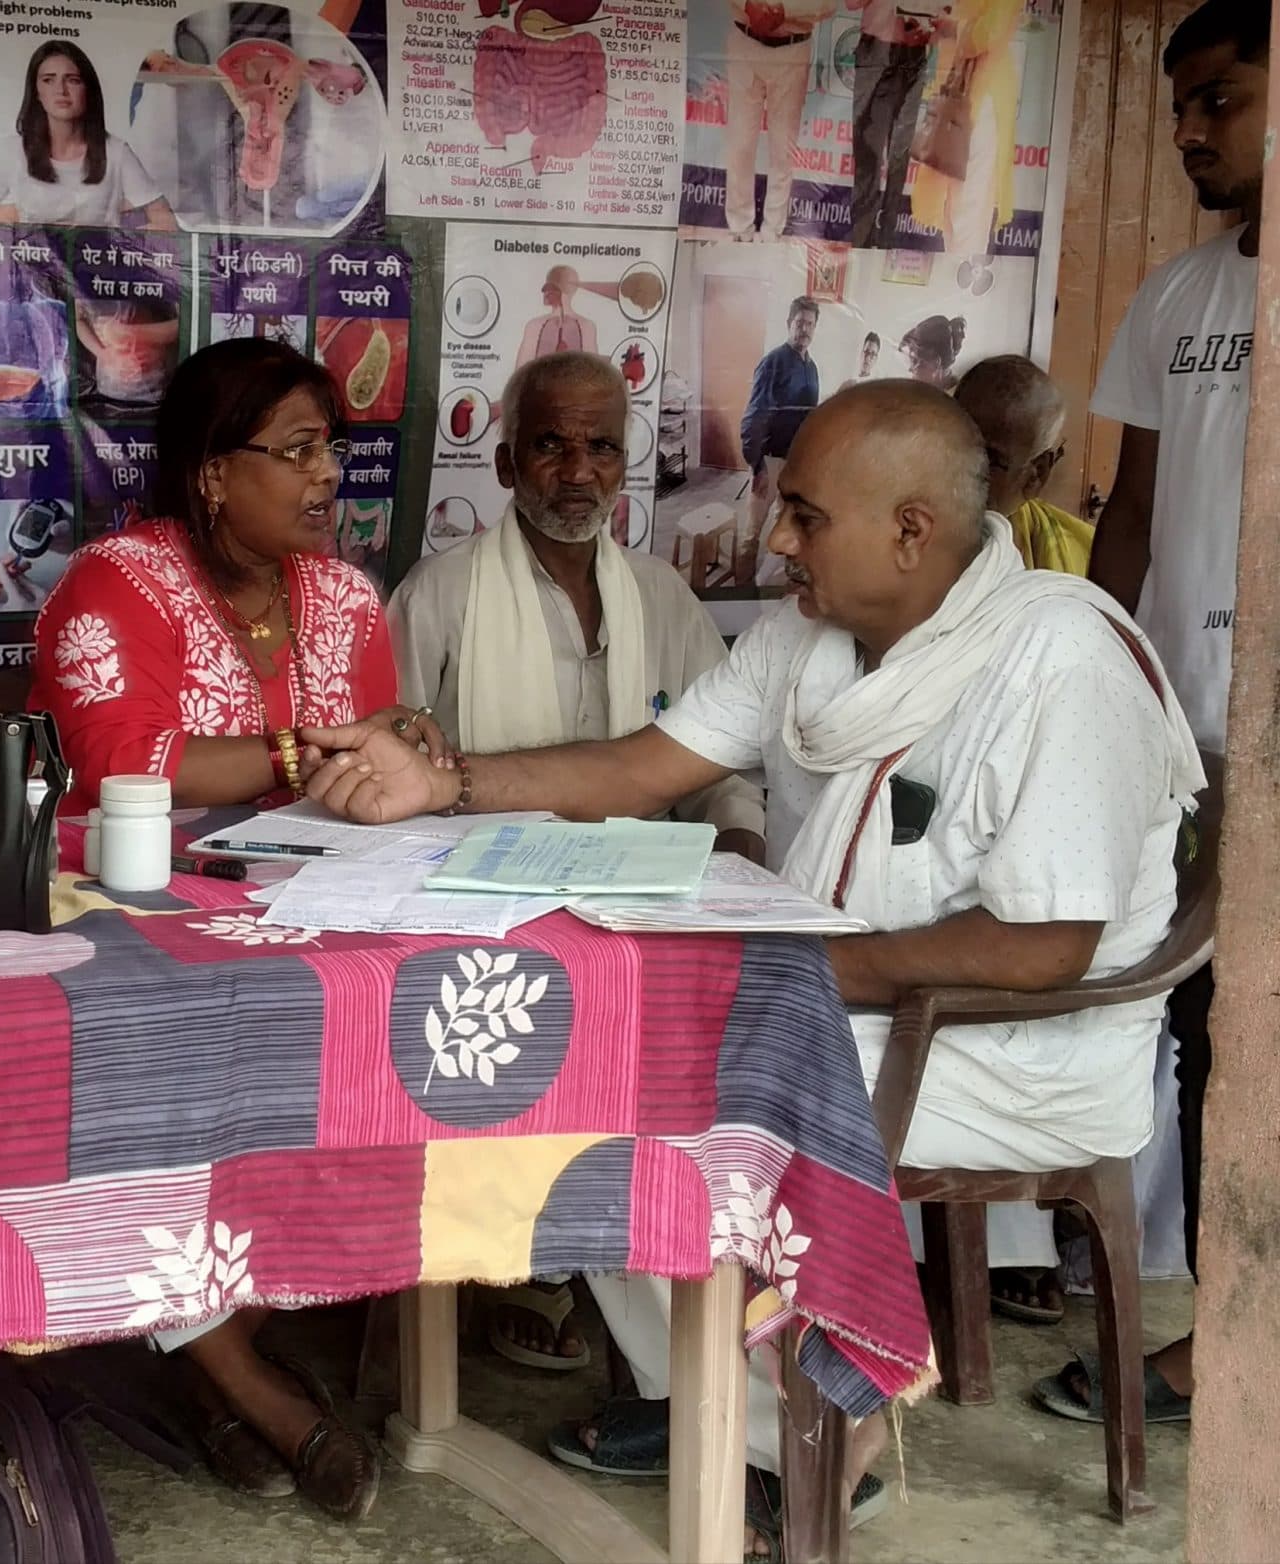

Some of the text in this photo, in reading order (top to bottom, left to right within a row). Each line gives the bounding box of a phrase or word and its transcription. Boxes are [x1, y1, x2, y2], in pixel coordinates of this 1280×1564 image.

[30, 6, 93, 20] problems
[17, 22, 80, 38] problems
[616, 16, 666, 31] Pancreas
[412, 62, 445, 76] Small
[406, 75, 457, 90] Intestine
[624, 88, 655, 103] Large
[624, 104, 669, 119] Intestine
[425, 141, 480, 156] Appendix
[480, 164, 522, 178] Rectum
[544, 158, 574, 173] Anus
[419, 194, 438, 206] Left
[441, 196, 464, 207] Side
[472, 196, 486, 207] S1
[494, 198, 521, 210] Lower
[526, 199, 548, 210] Side
[556, 201, 576, 211] S10
[583, 201, 608, 215] Right
[610, 202, 631, 213] Side
[816, 201, 852, 225] INDIA
[11, 239, 52, 264] लीवर
[82, 244, 102, 268] पेट
[107, 245, 121, 268] में
[494, 239, 642, 258] Diabetes Complications
[243, 252, 305, 279] (किडनी)
[328, 253, 402, 279] पित्त की
[92, 275, 164, 299] गैस व कब्ज
[241, 285, 277, 305] पथरी
[339, 287, 391, 308] पथरी
[447, 341, 462, 352] Eye
[94, 437, 160, 461] ब्लड प्रेशर
[112, 466, 146, 491] (BP)
[349, 464, 391, 484] बवासीर
